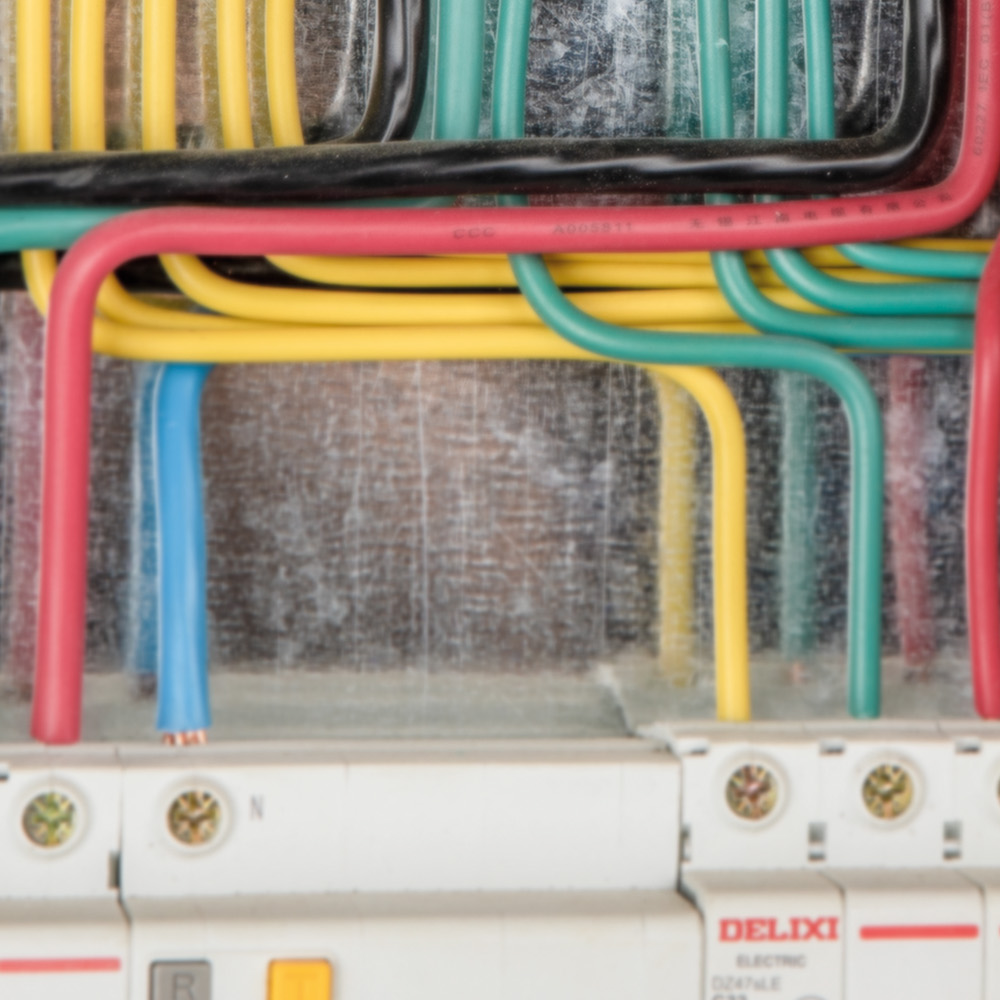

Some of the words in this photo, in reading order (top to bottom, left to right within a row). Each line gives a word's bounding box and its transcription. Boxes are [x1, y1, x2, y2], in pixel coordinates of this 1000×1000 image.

[978, 57, 990, 92] IEC
[972, 103, 988, 157] 60227
[453, 227, 497, 240] CCC
[250, 796, 264, 821] N
[718, 916, 839, 942] DELIXI
[735, 953, 806, 969] ELECTRIC
[173, 972, 196, 1000] R
